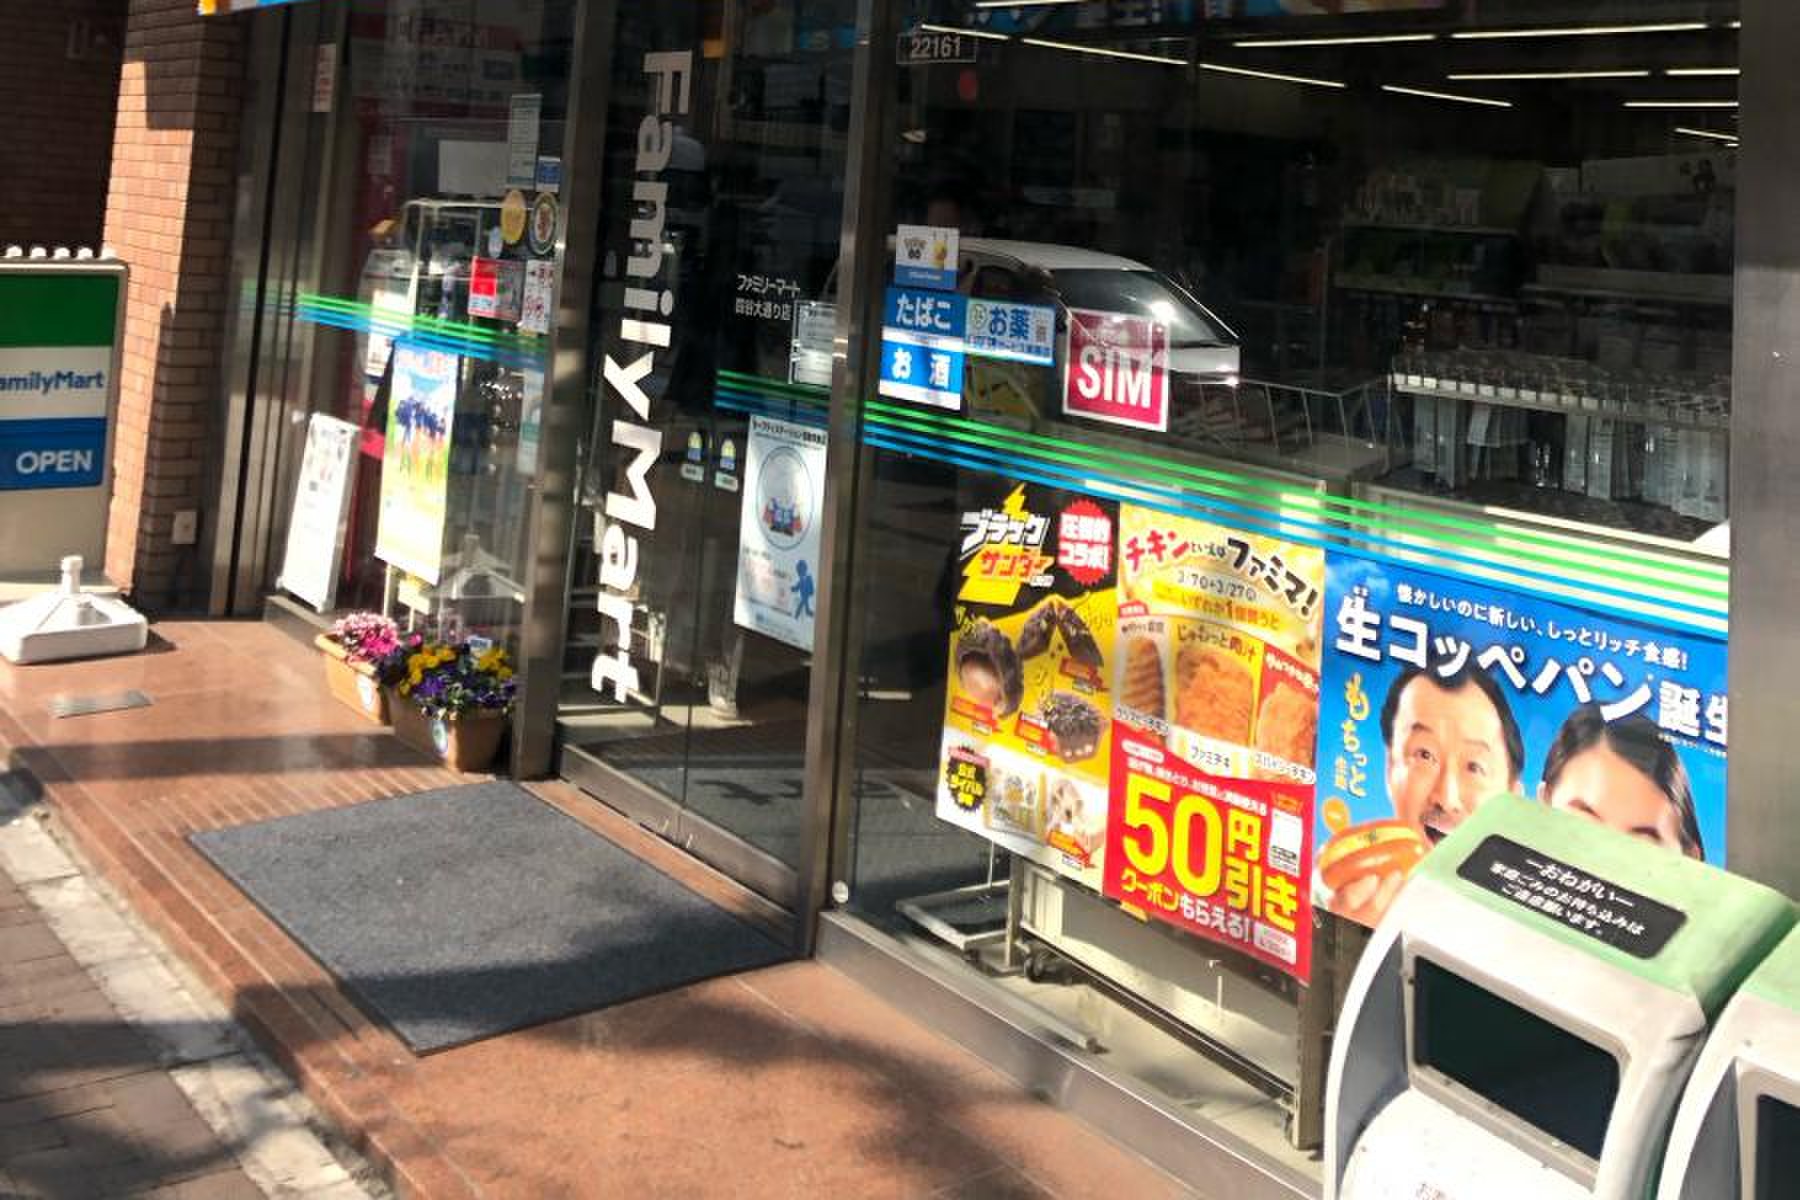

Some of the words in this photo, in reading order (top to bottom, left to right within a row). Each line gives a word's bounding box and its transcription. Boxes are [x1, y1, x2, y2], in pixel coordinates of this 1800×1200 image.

[910, 35, 961, 59] 22161
[895, 293, 952, 331] たばこ
[0, 370, 104, 396] amilyMart
[591, 50, 692, 703] FamilyMart
[1077, 345, 1153, 409] SIM
[15, 449, 94, 474] OPEN
[960, 509, 1051, 561] ブラック
